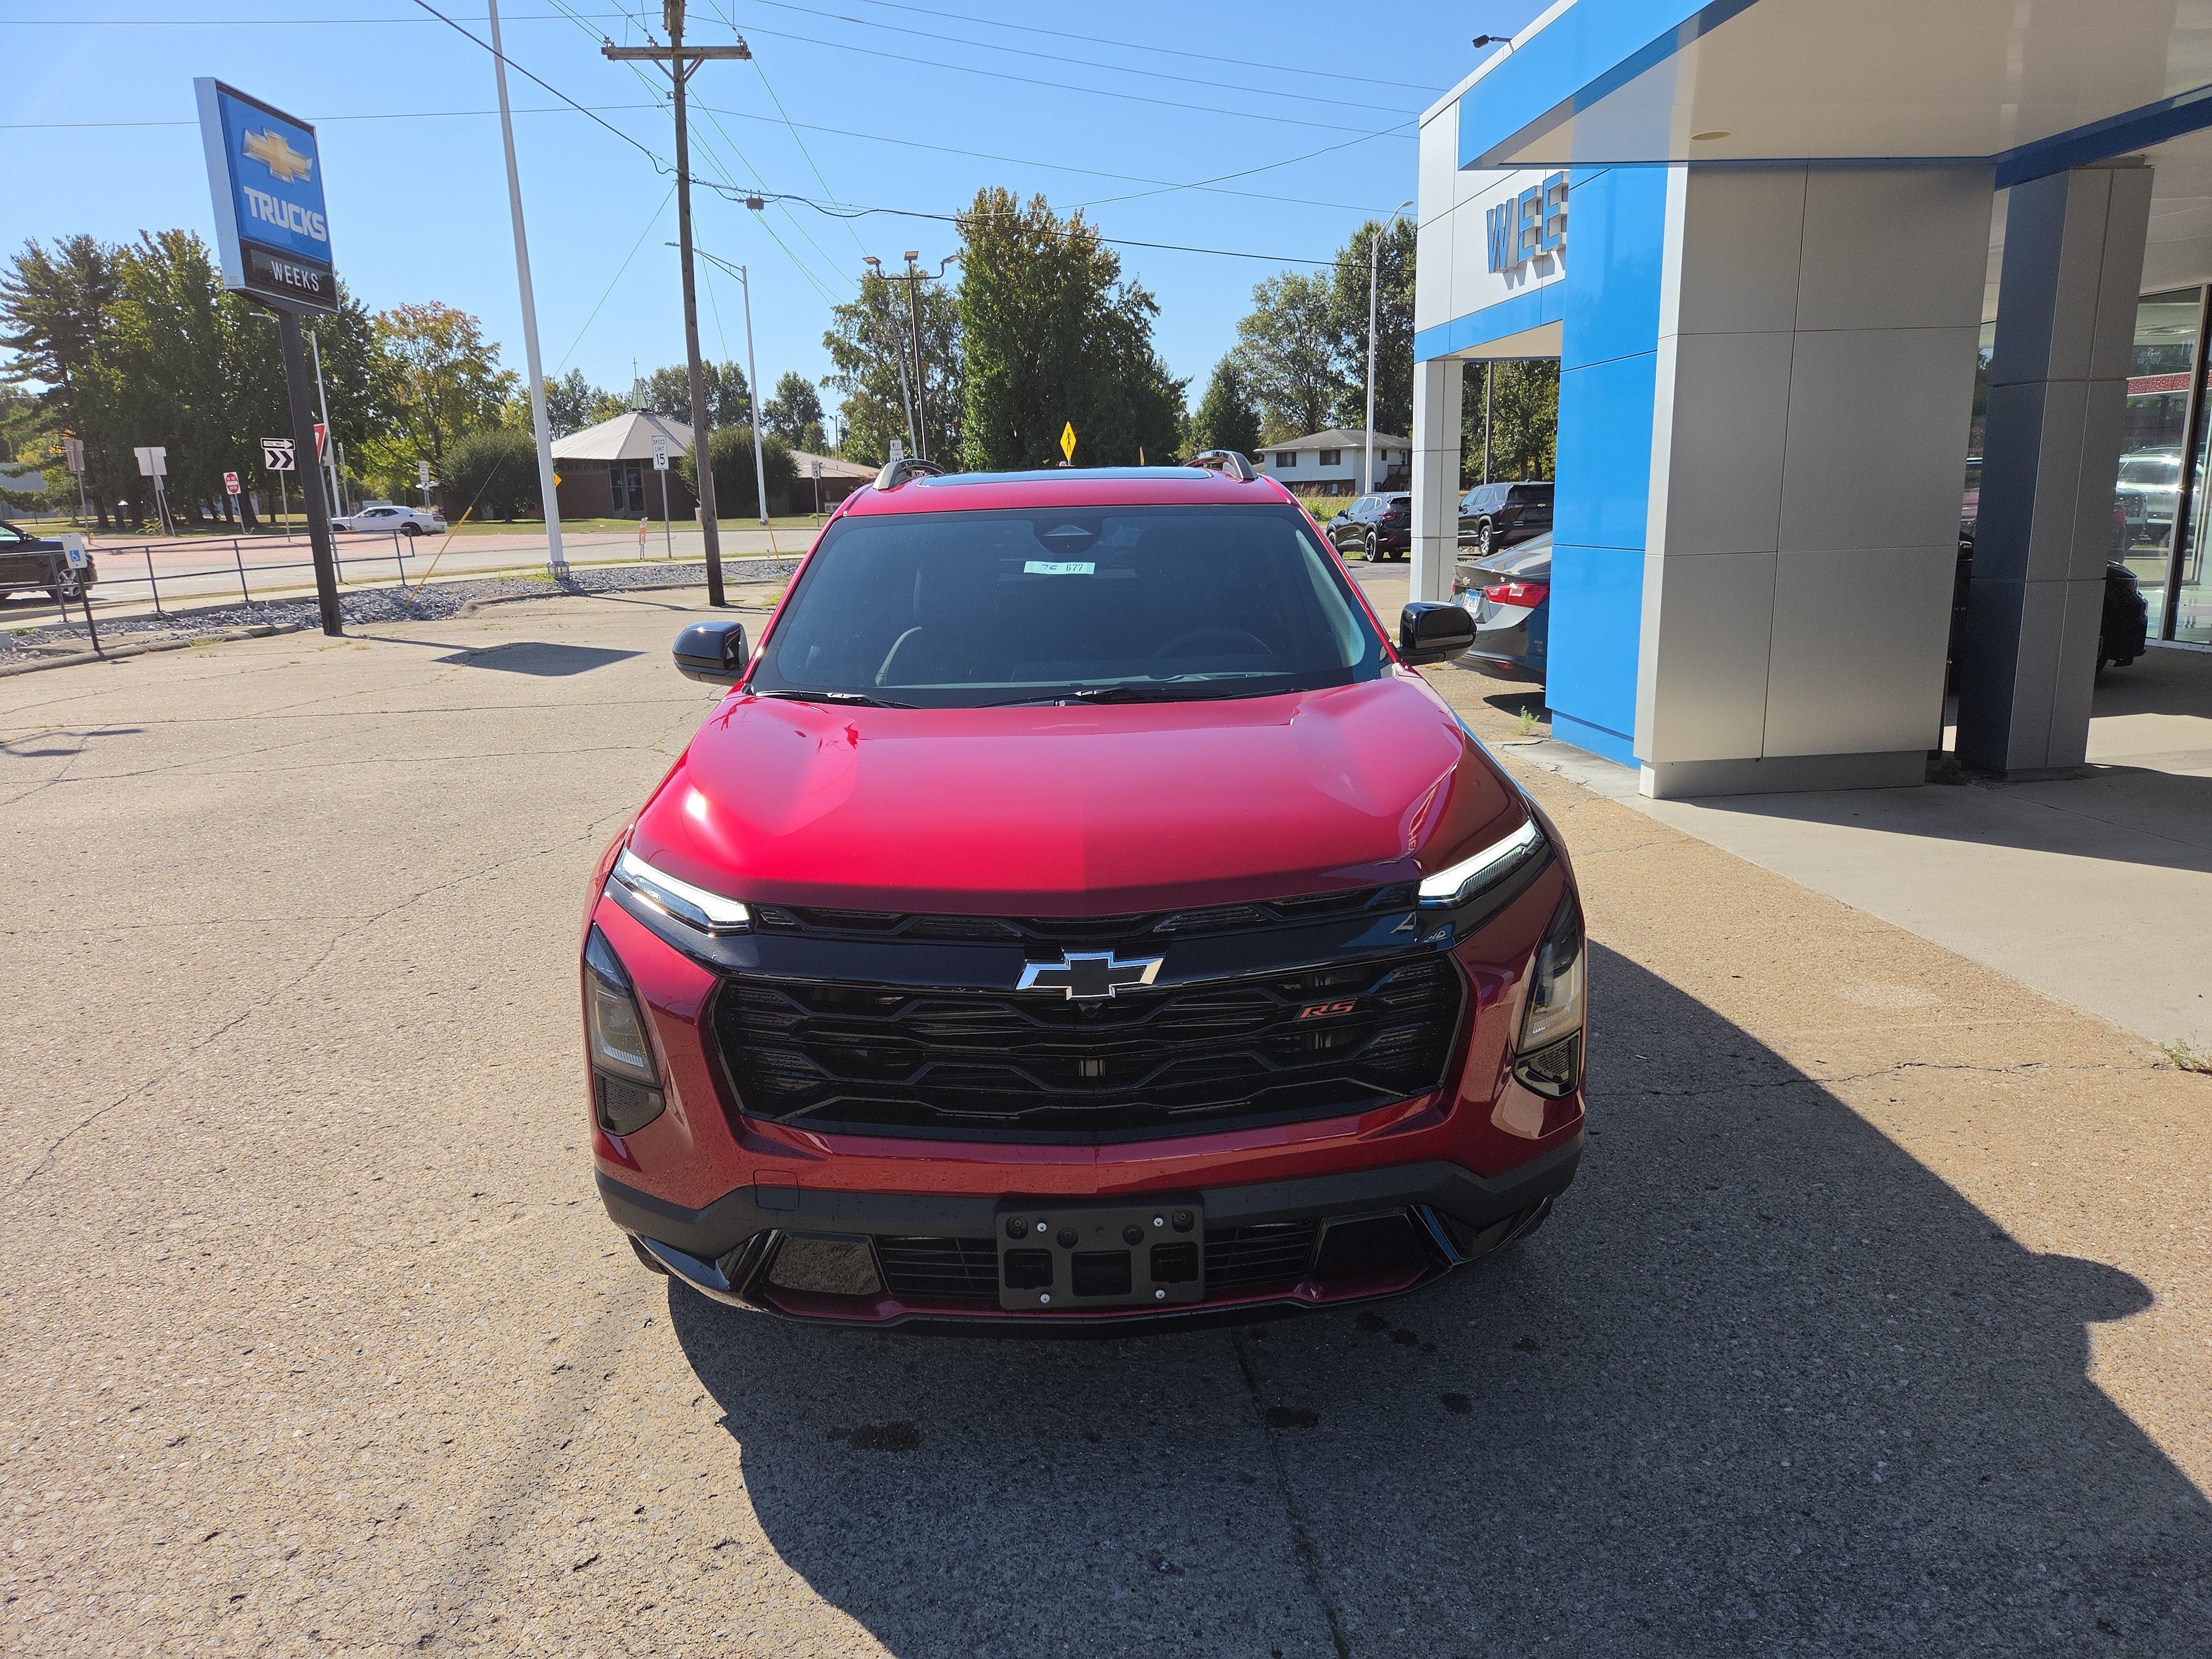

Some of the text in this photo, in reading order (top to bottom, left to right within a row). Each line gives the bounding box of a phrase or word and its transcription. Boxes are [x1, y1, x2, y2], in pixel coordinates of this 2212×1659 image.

[243, 185, 326, 242] TRUCKS
[271, 260, 319, 292] WEEKS
[656, 453, 665, 465] 15
[1300, 1000, 1355, 1019] RS
